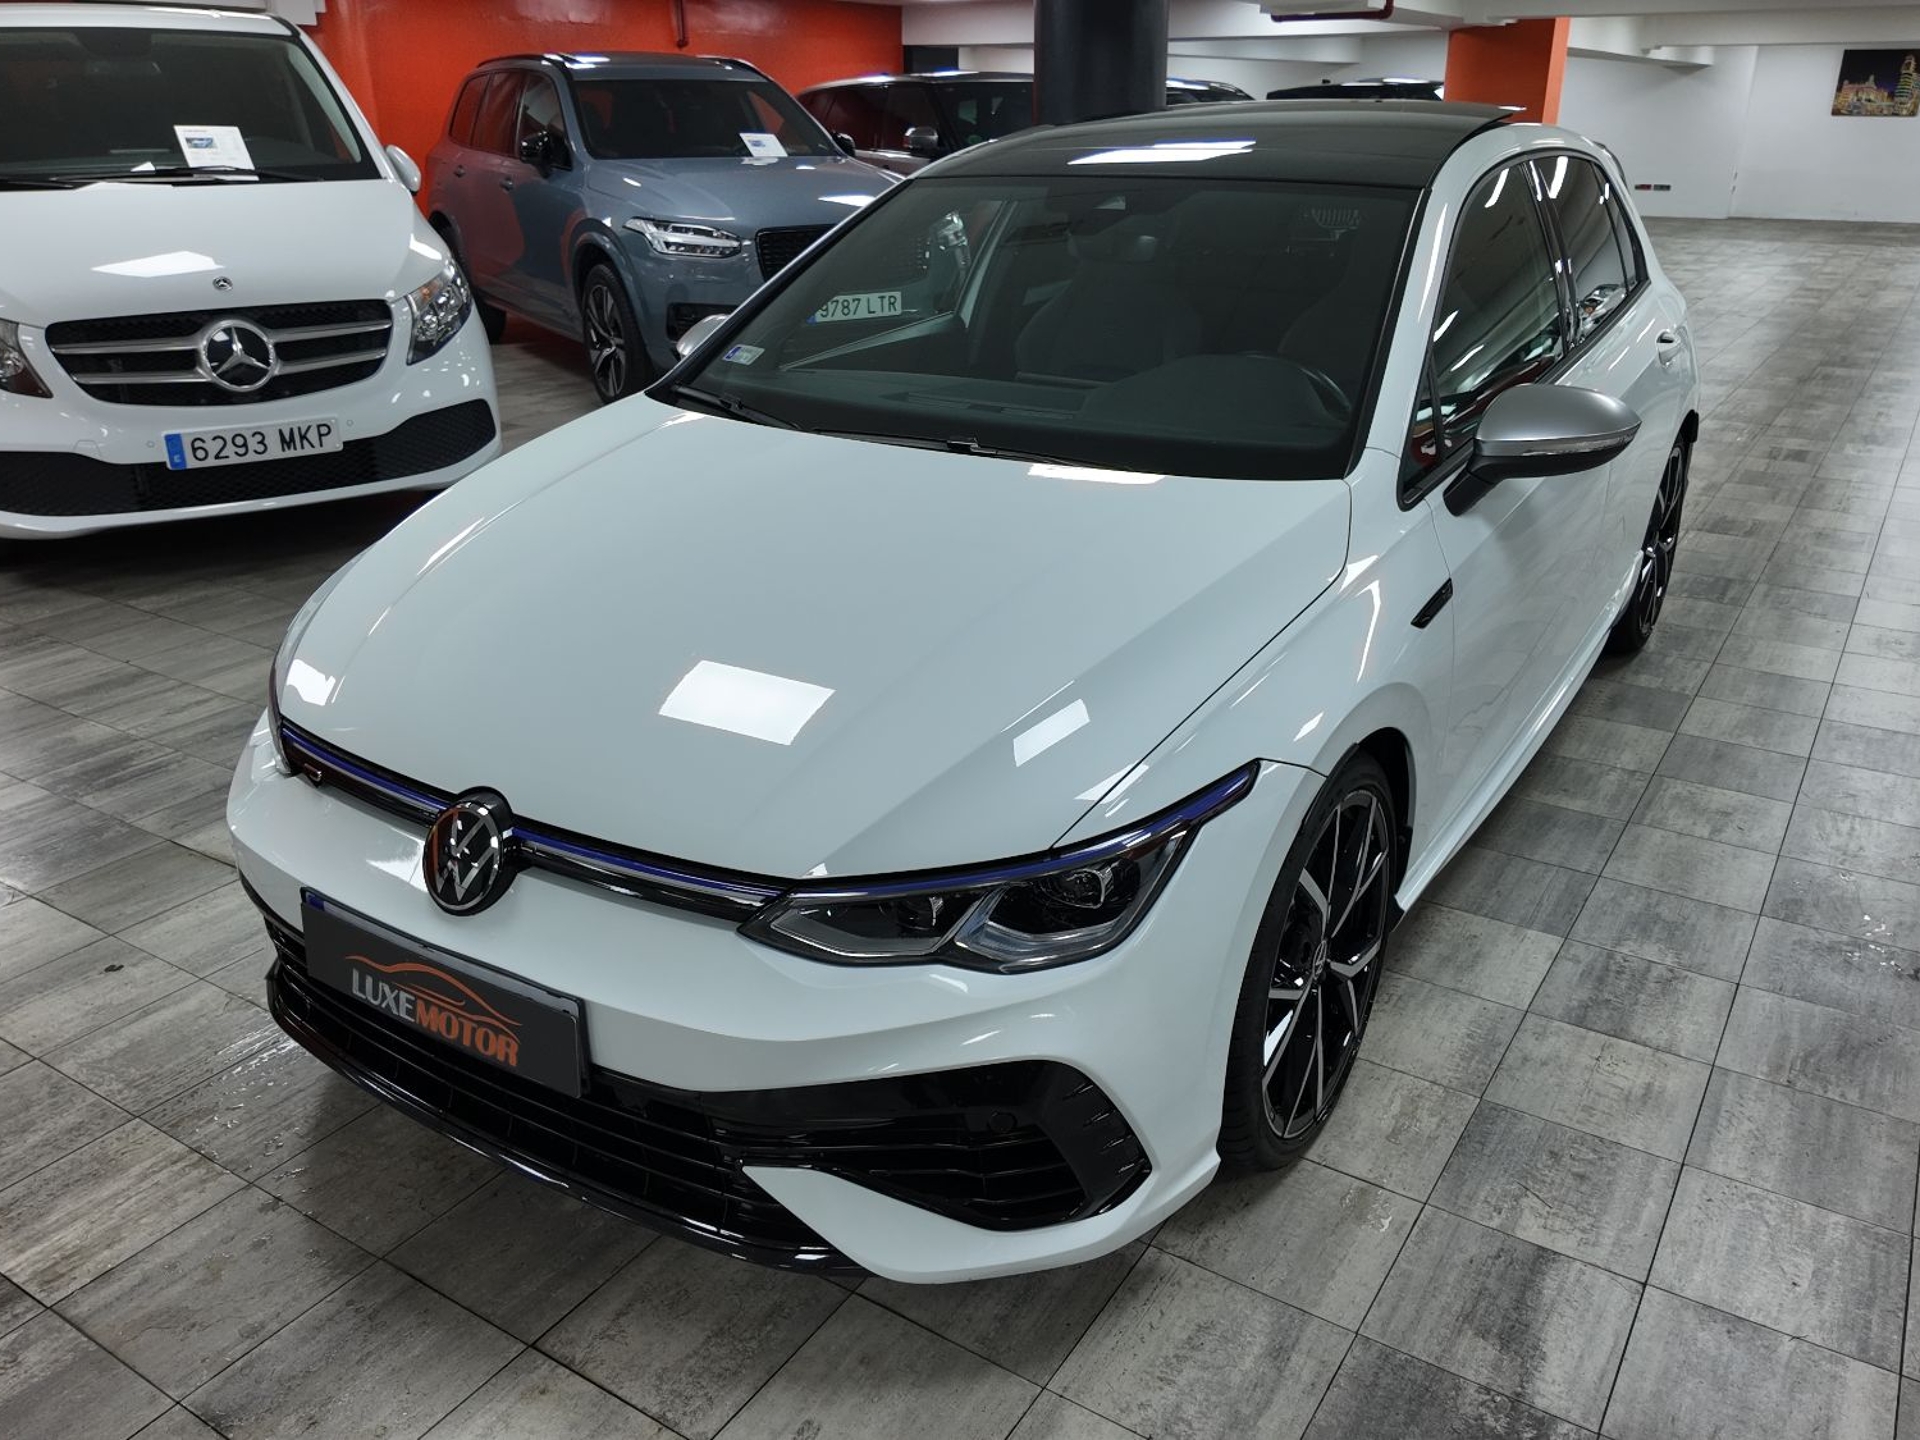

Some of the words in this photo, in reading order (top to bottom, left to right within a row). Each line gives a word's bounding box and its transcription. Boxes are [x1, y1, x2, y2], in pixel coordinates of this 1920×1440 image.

[867, 295, 897, 314] LTR
[190, 431, 268, 462] 6293
[278, 423, 332, 452] MKP
[352, 967, 519, 1067] LUXEMOTOR
